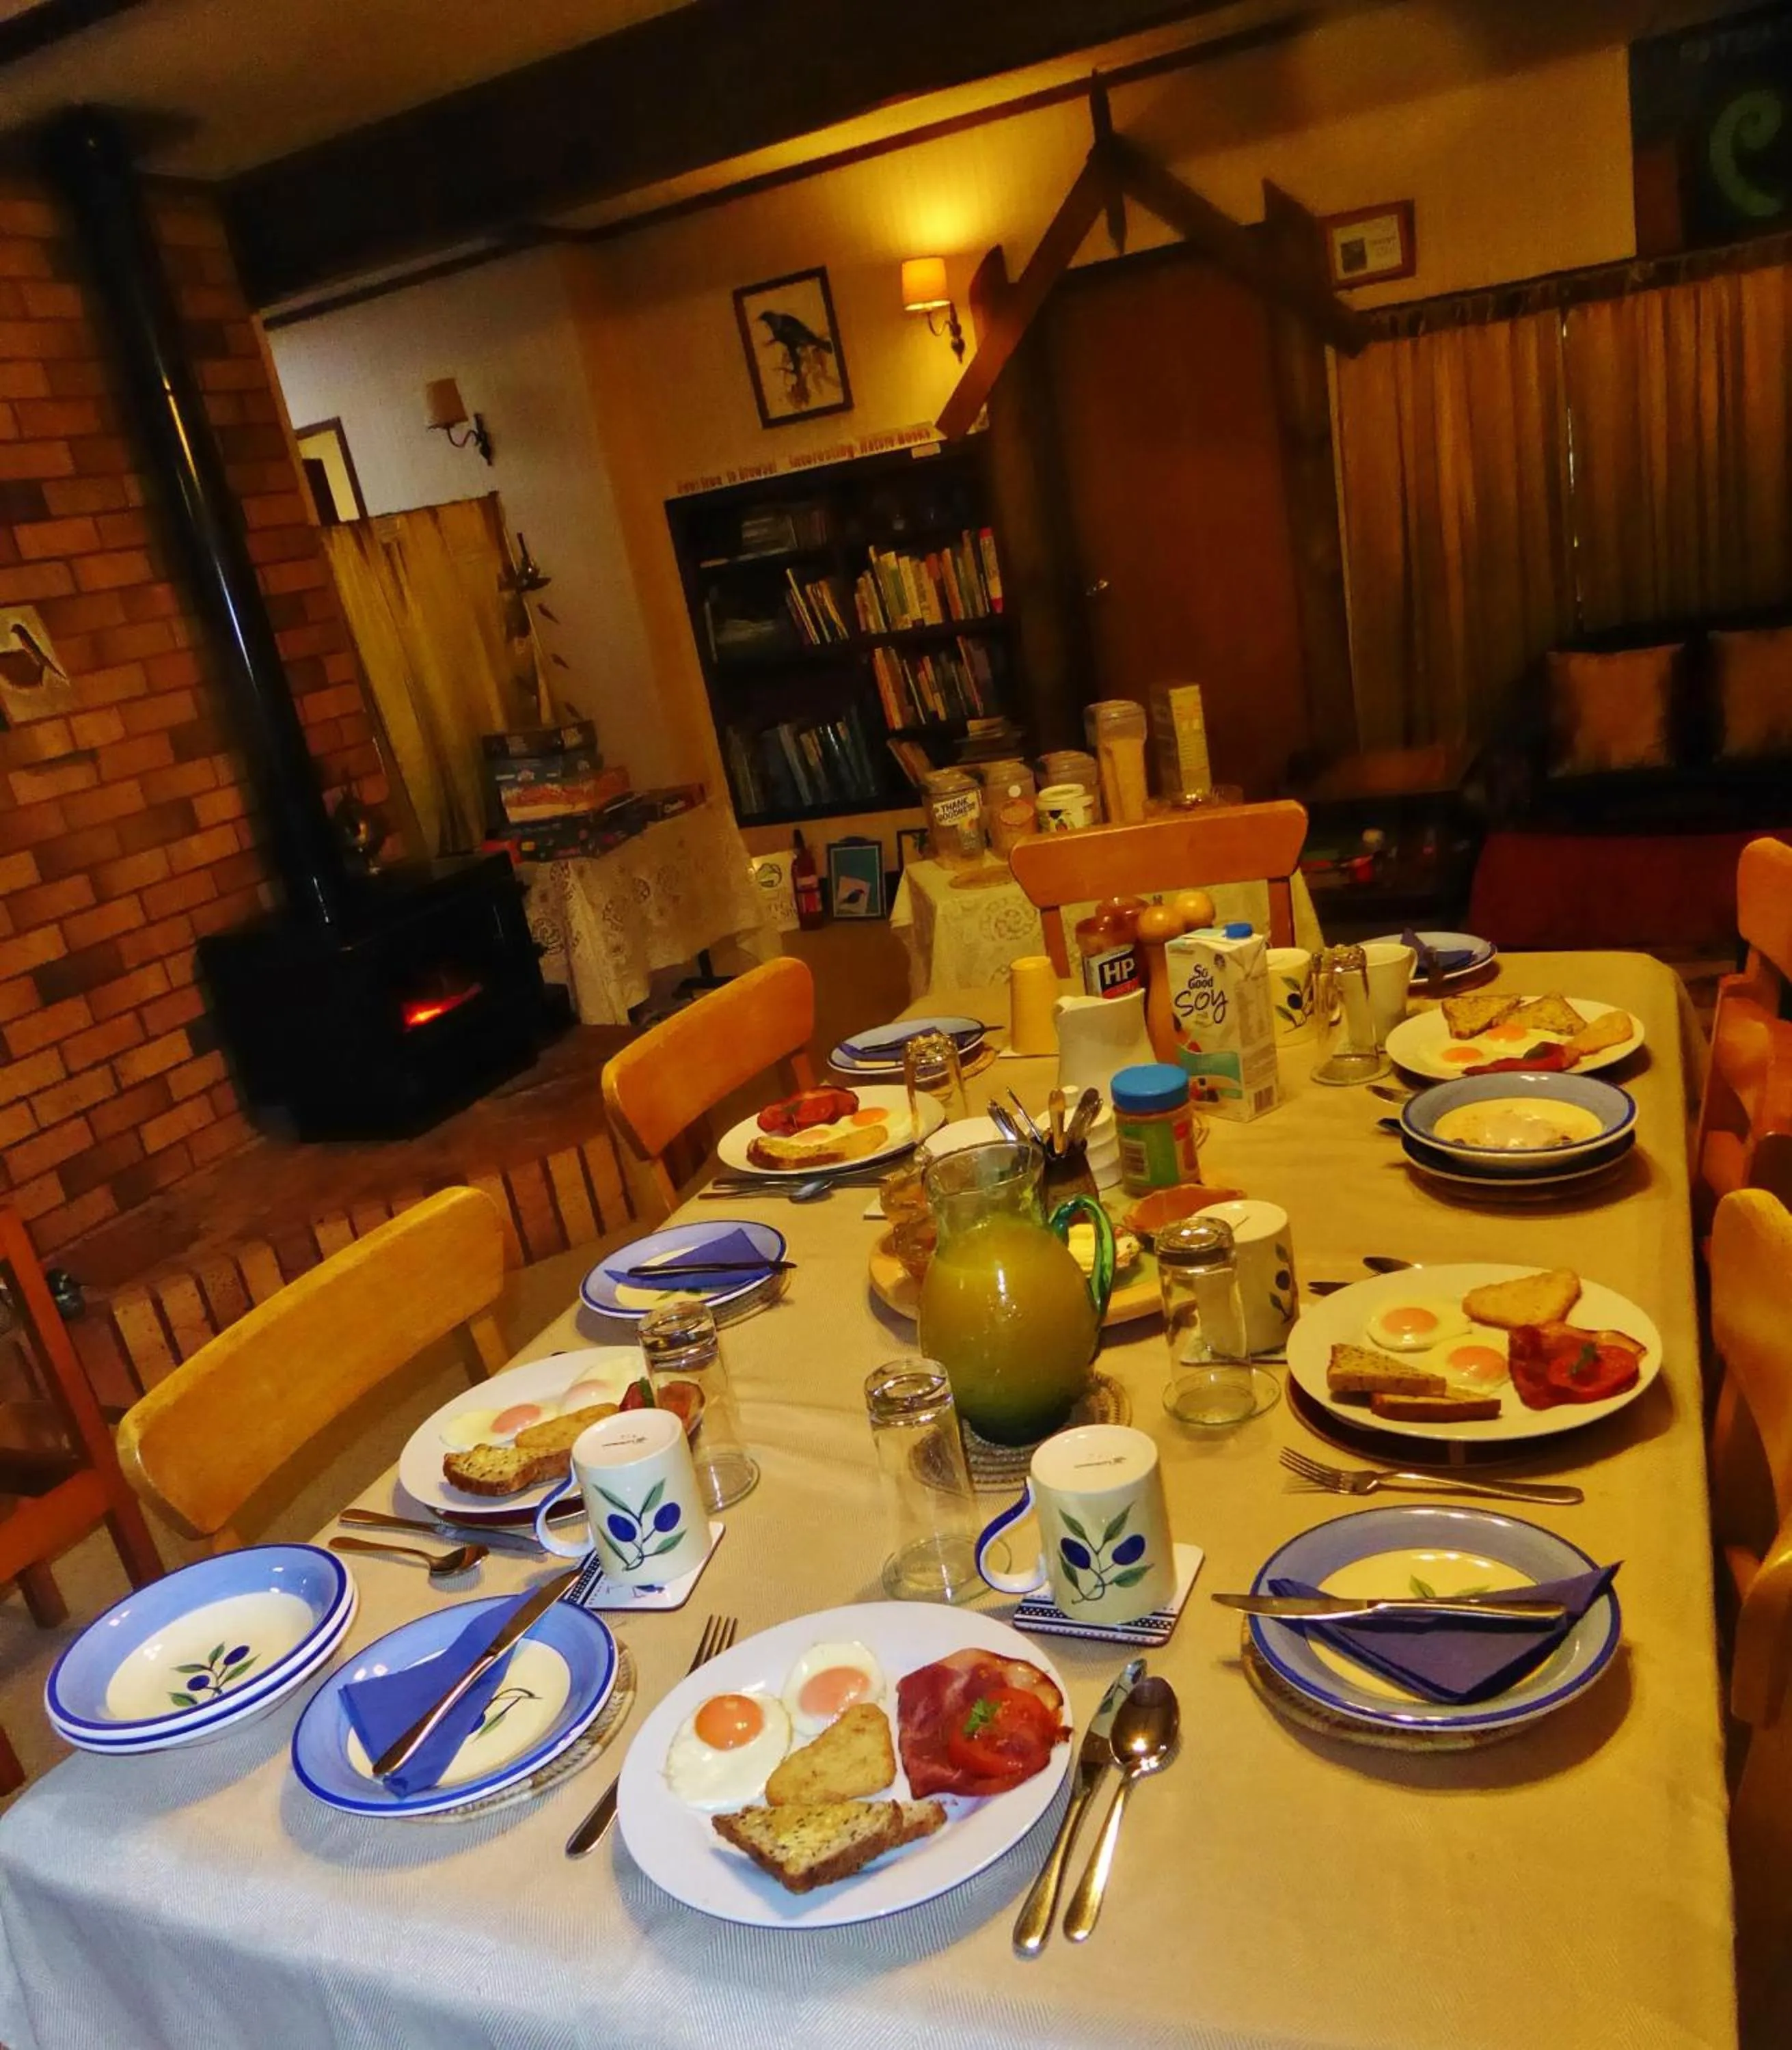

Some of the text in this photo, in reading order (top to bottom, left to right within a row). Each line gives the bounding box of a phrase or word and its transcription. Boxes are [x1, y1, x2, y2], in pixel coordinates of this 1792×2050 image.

[940, 797, 968, 812] THANK
[1103, 958, 1135, 985] HP
[1193, 964, 1208, 978] So
[1188, 976, 1214, 989] Good
